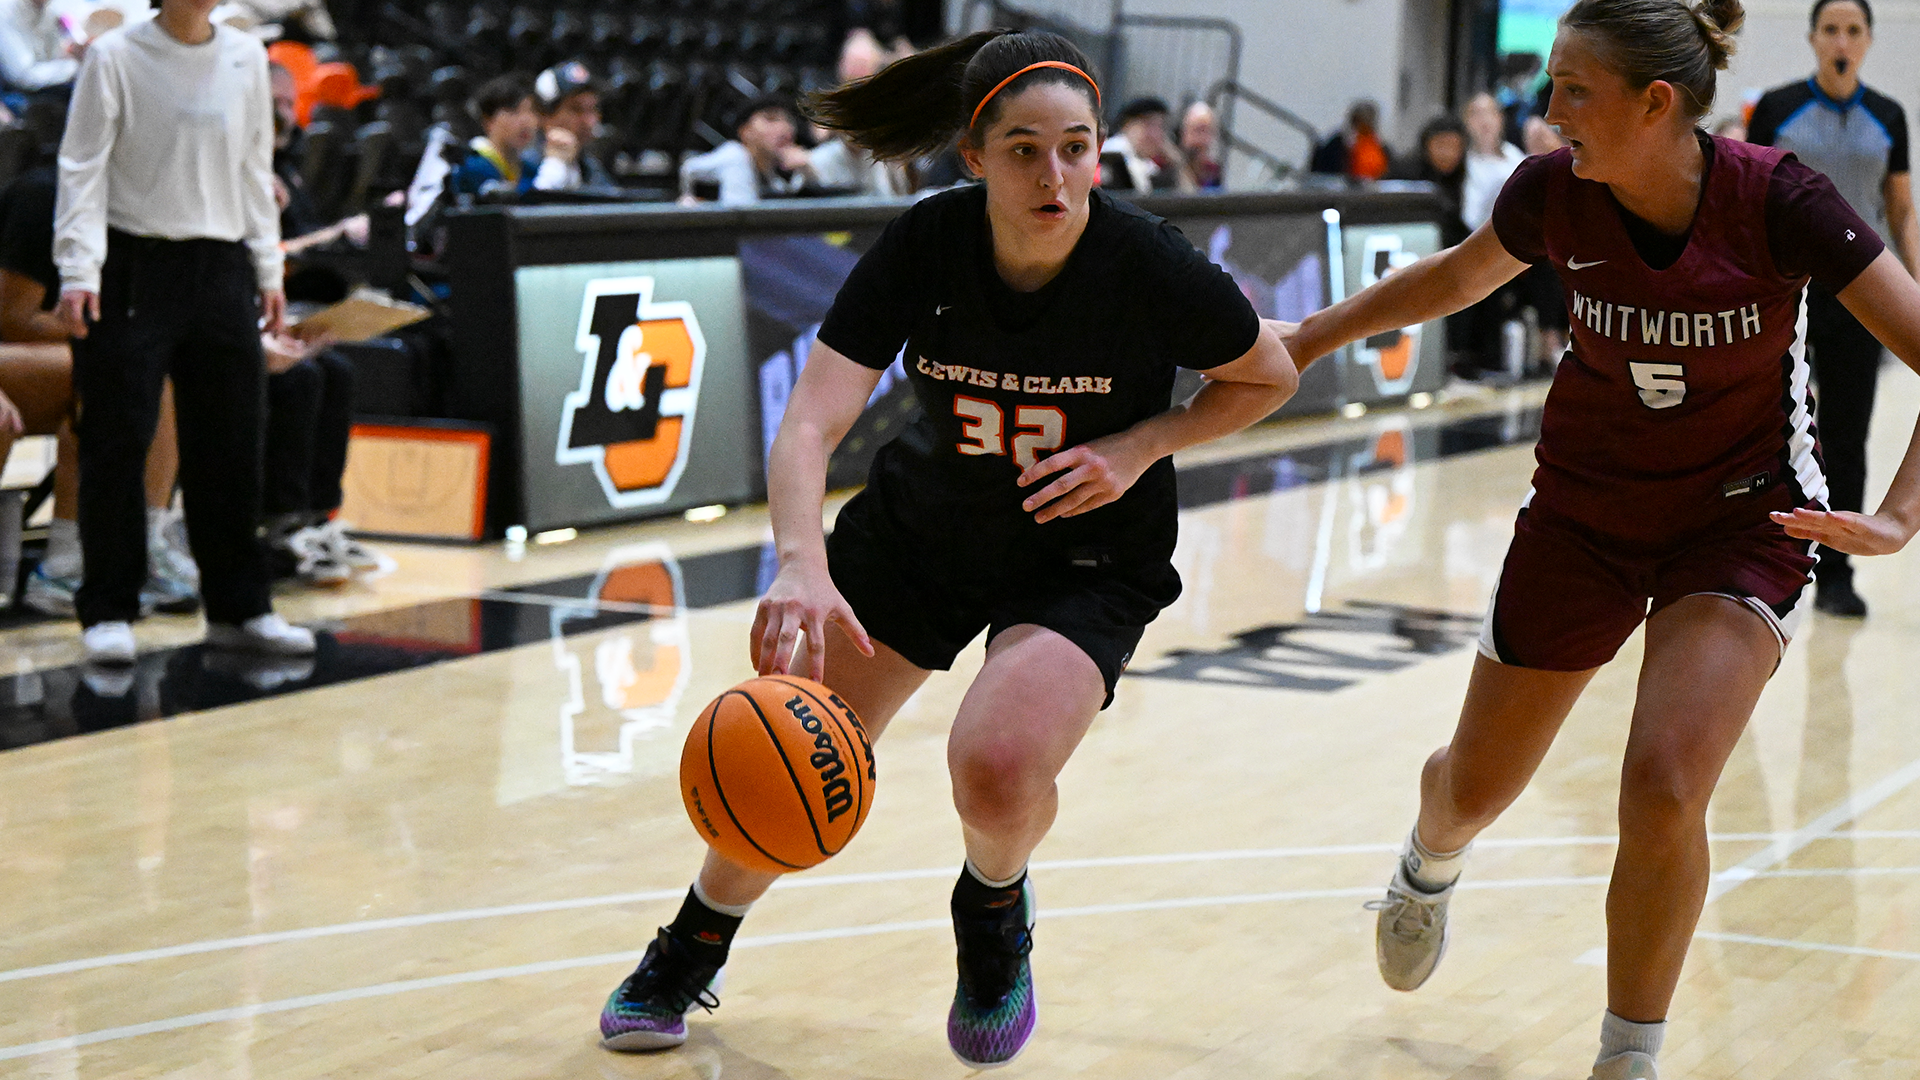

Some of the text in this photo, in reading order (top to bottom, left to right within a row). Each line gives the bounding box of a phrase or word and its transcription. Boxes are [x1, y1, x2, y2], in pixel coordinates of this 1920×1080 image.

[1572, 289, 1761, 348] WHITWORTH
[916, 355, 1113, 394] LEWIS & CLARK
[1628, 361, 1687, 410] 5
[953, 393, 1067, 474] 32
[784, 695, 854, 824] Wilson
